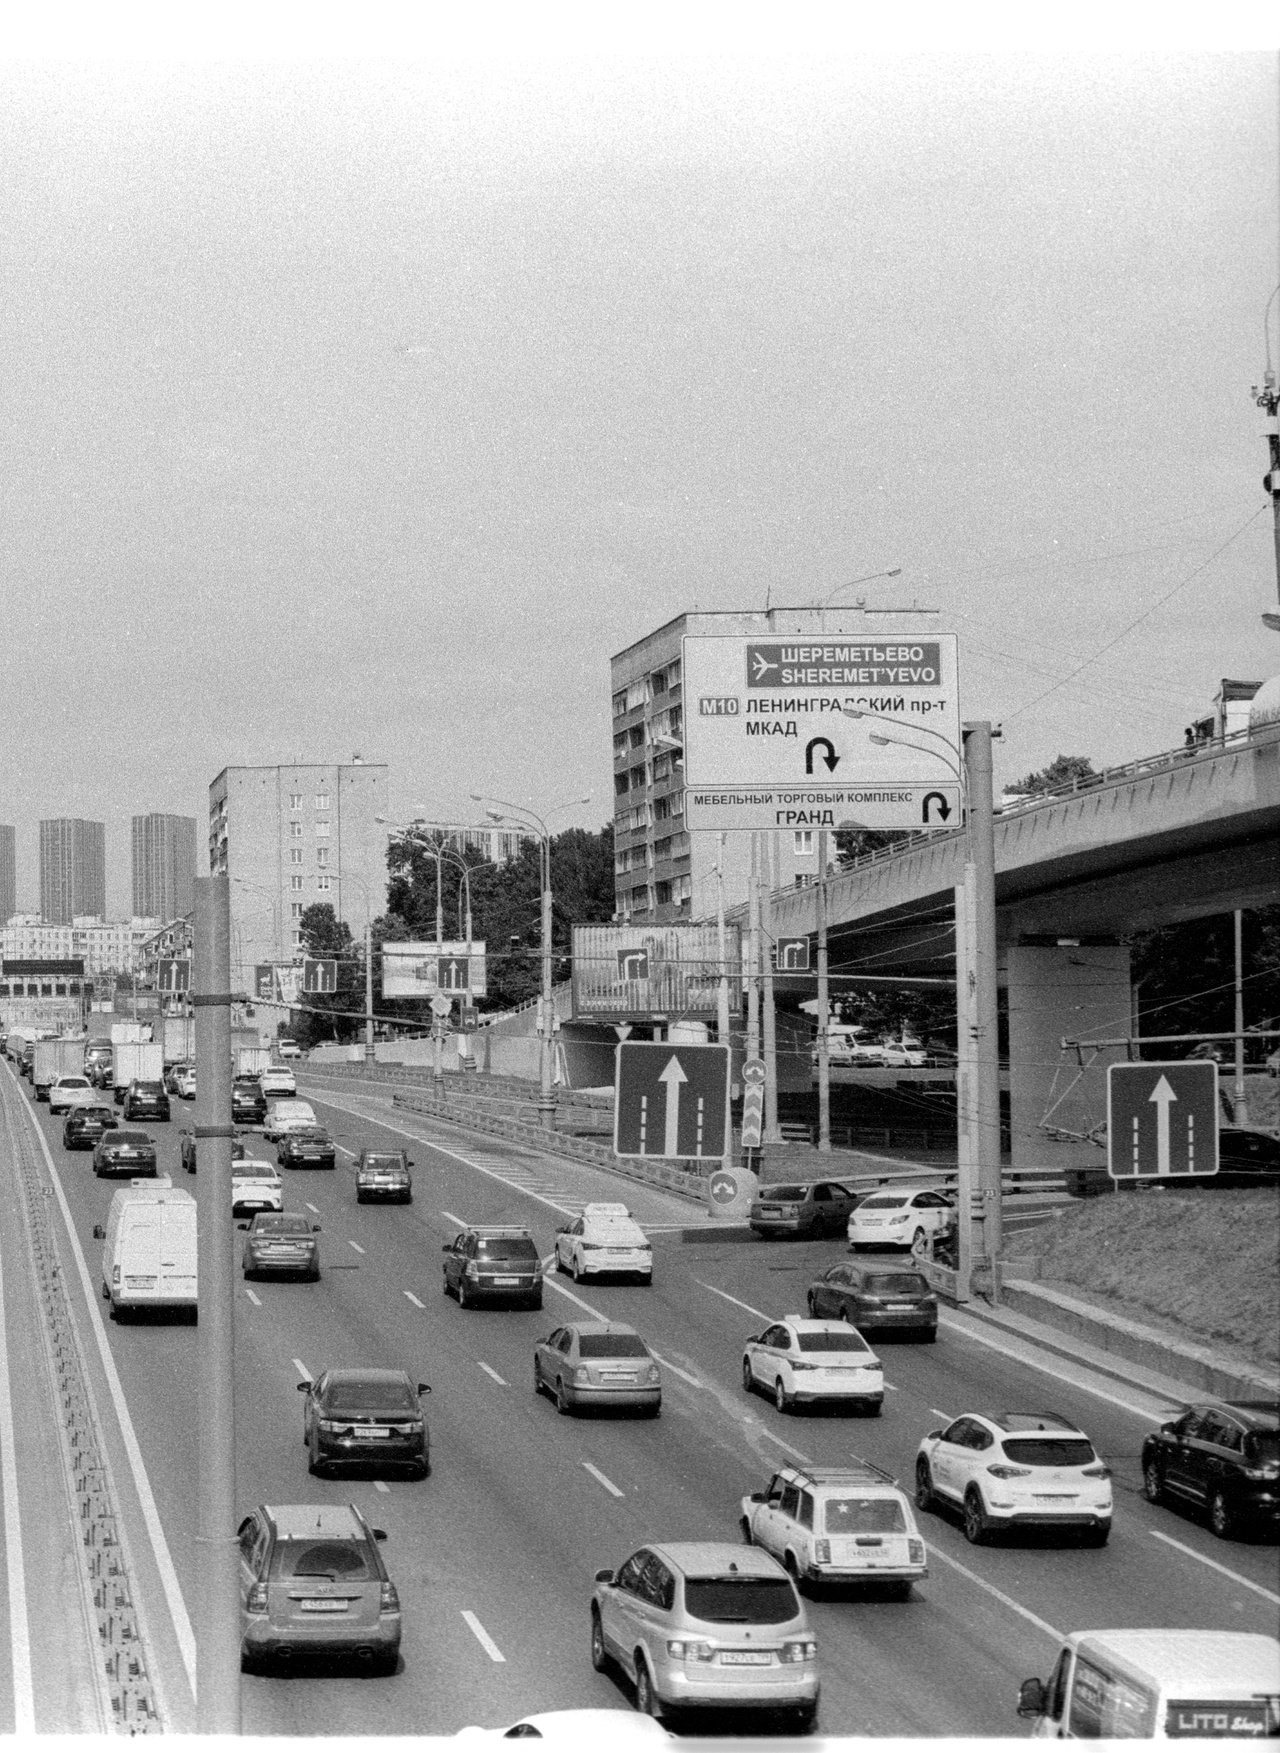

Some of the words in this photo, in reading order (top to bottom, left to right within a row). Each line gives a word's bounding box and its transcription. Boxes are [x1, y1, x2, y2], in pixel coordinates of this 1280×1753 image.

[781, 647, 923, 663] ШЕРЕМЕТЬЕВО
[910, 700, 946, 714] пр-т
[746, 721, 798, 737] МКАД
[694, 793, 772, 805] МЕБЕЛЬНЫЙ
[777, 791, 844, 804] ТОРГОВЫЙ
[848, 792, 912, 803] КОМПЛЕКС
[776, 810, 834, 826] ГРАНД
[1179, 1714, 1228, 1729] LITO
